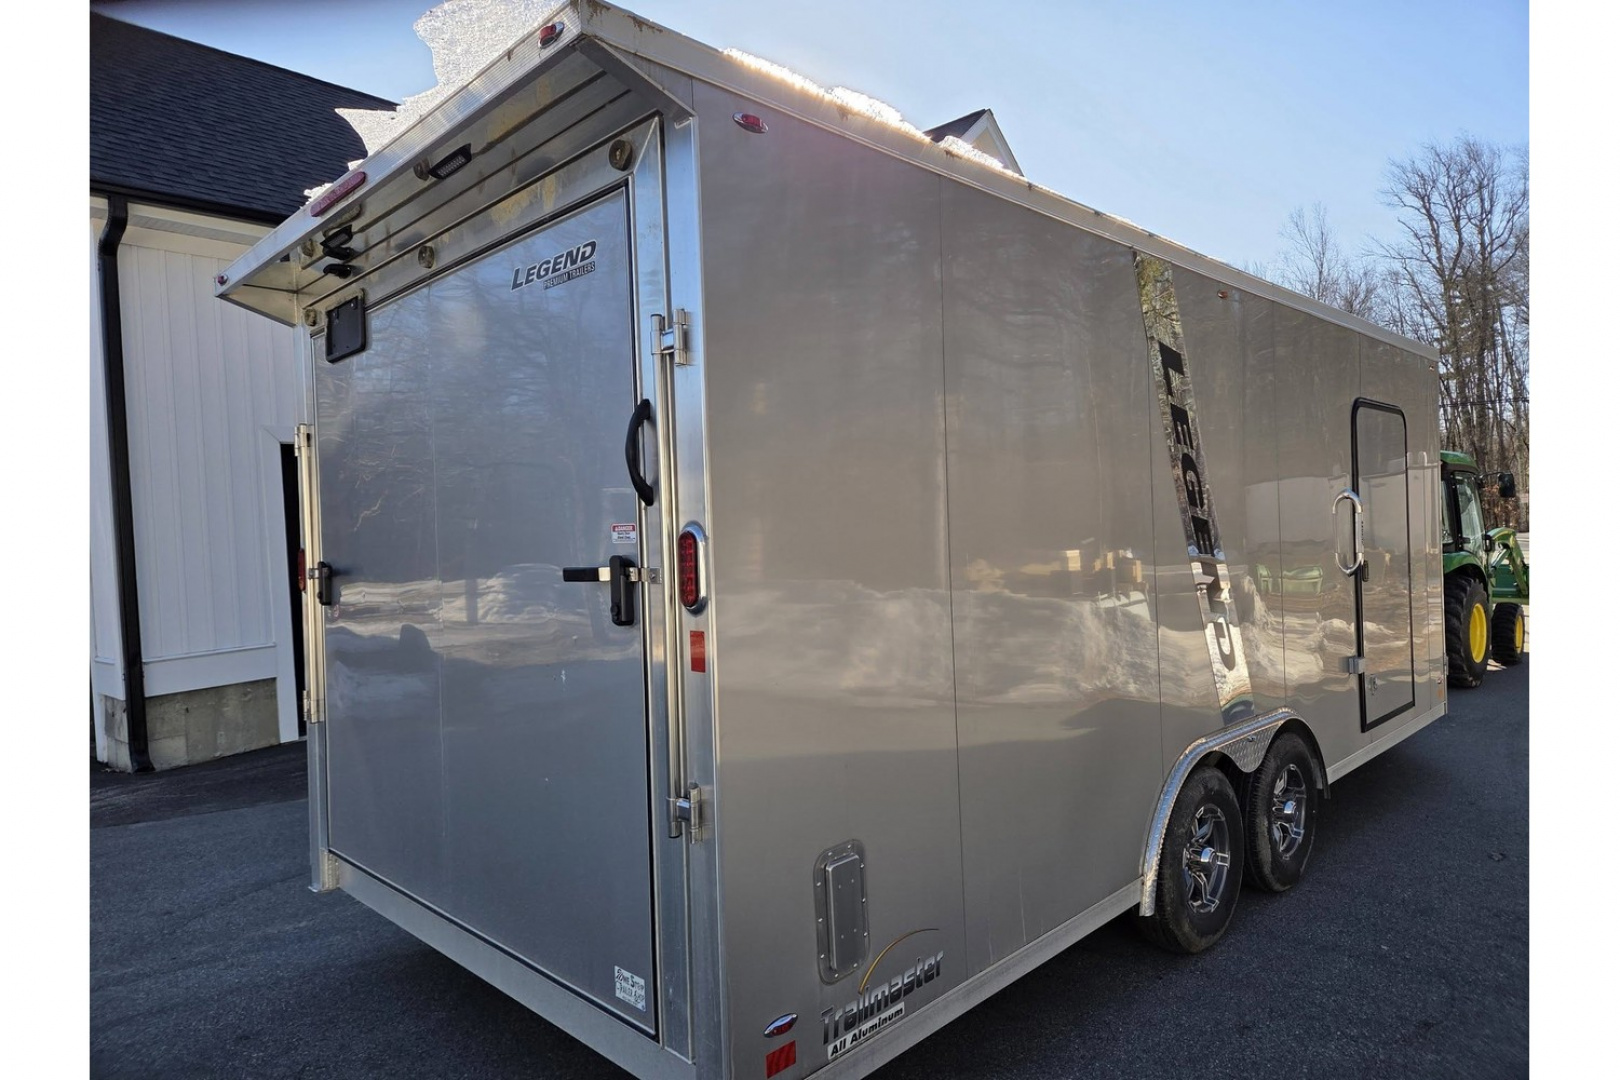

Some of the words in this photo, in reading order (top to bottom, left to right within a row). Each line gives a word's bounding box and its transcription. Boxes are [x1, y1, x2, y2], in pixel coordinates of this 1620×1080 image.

[510, 240, 597, 291] LEGEND
[543, 271, 569, 290] PREMIUM
[569, 261, 595, 280] TRAILERS
[1158, 340, 1237, 671] LEGEND
[820, 951, 944, 1045] Trailmaster
[830, 1037, 847, 1057] All
[850, 1006, 903, 1045] Aluminum
